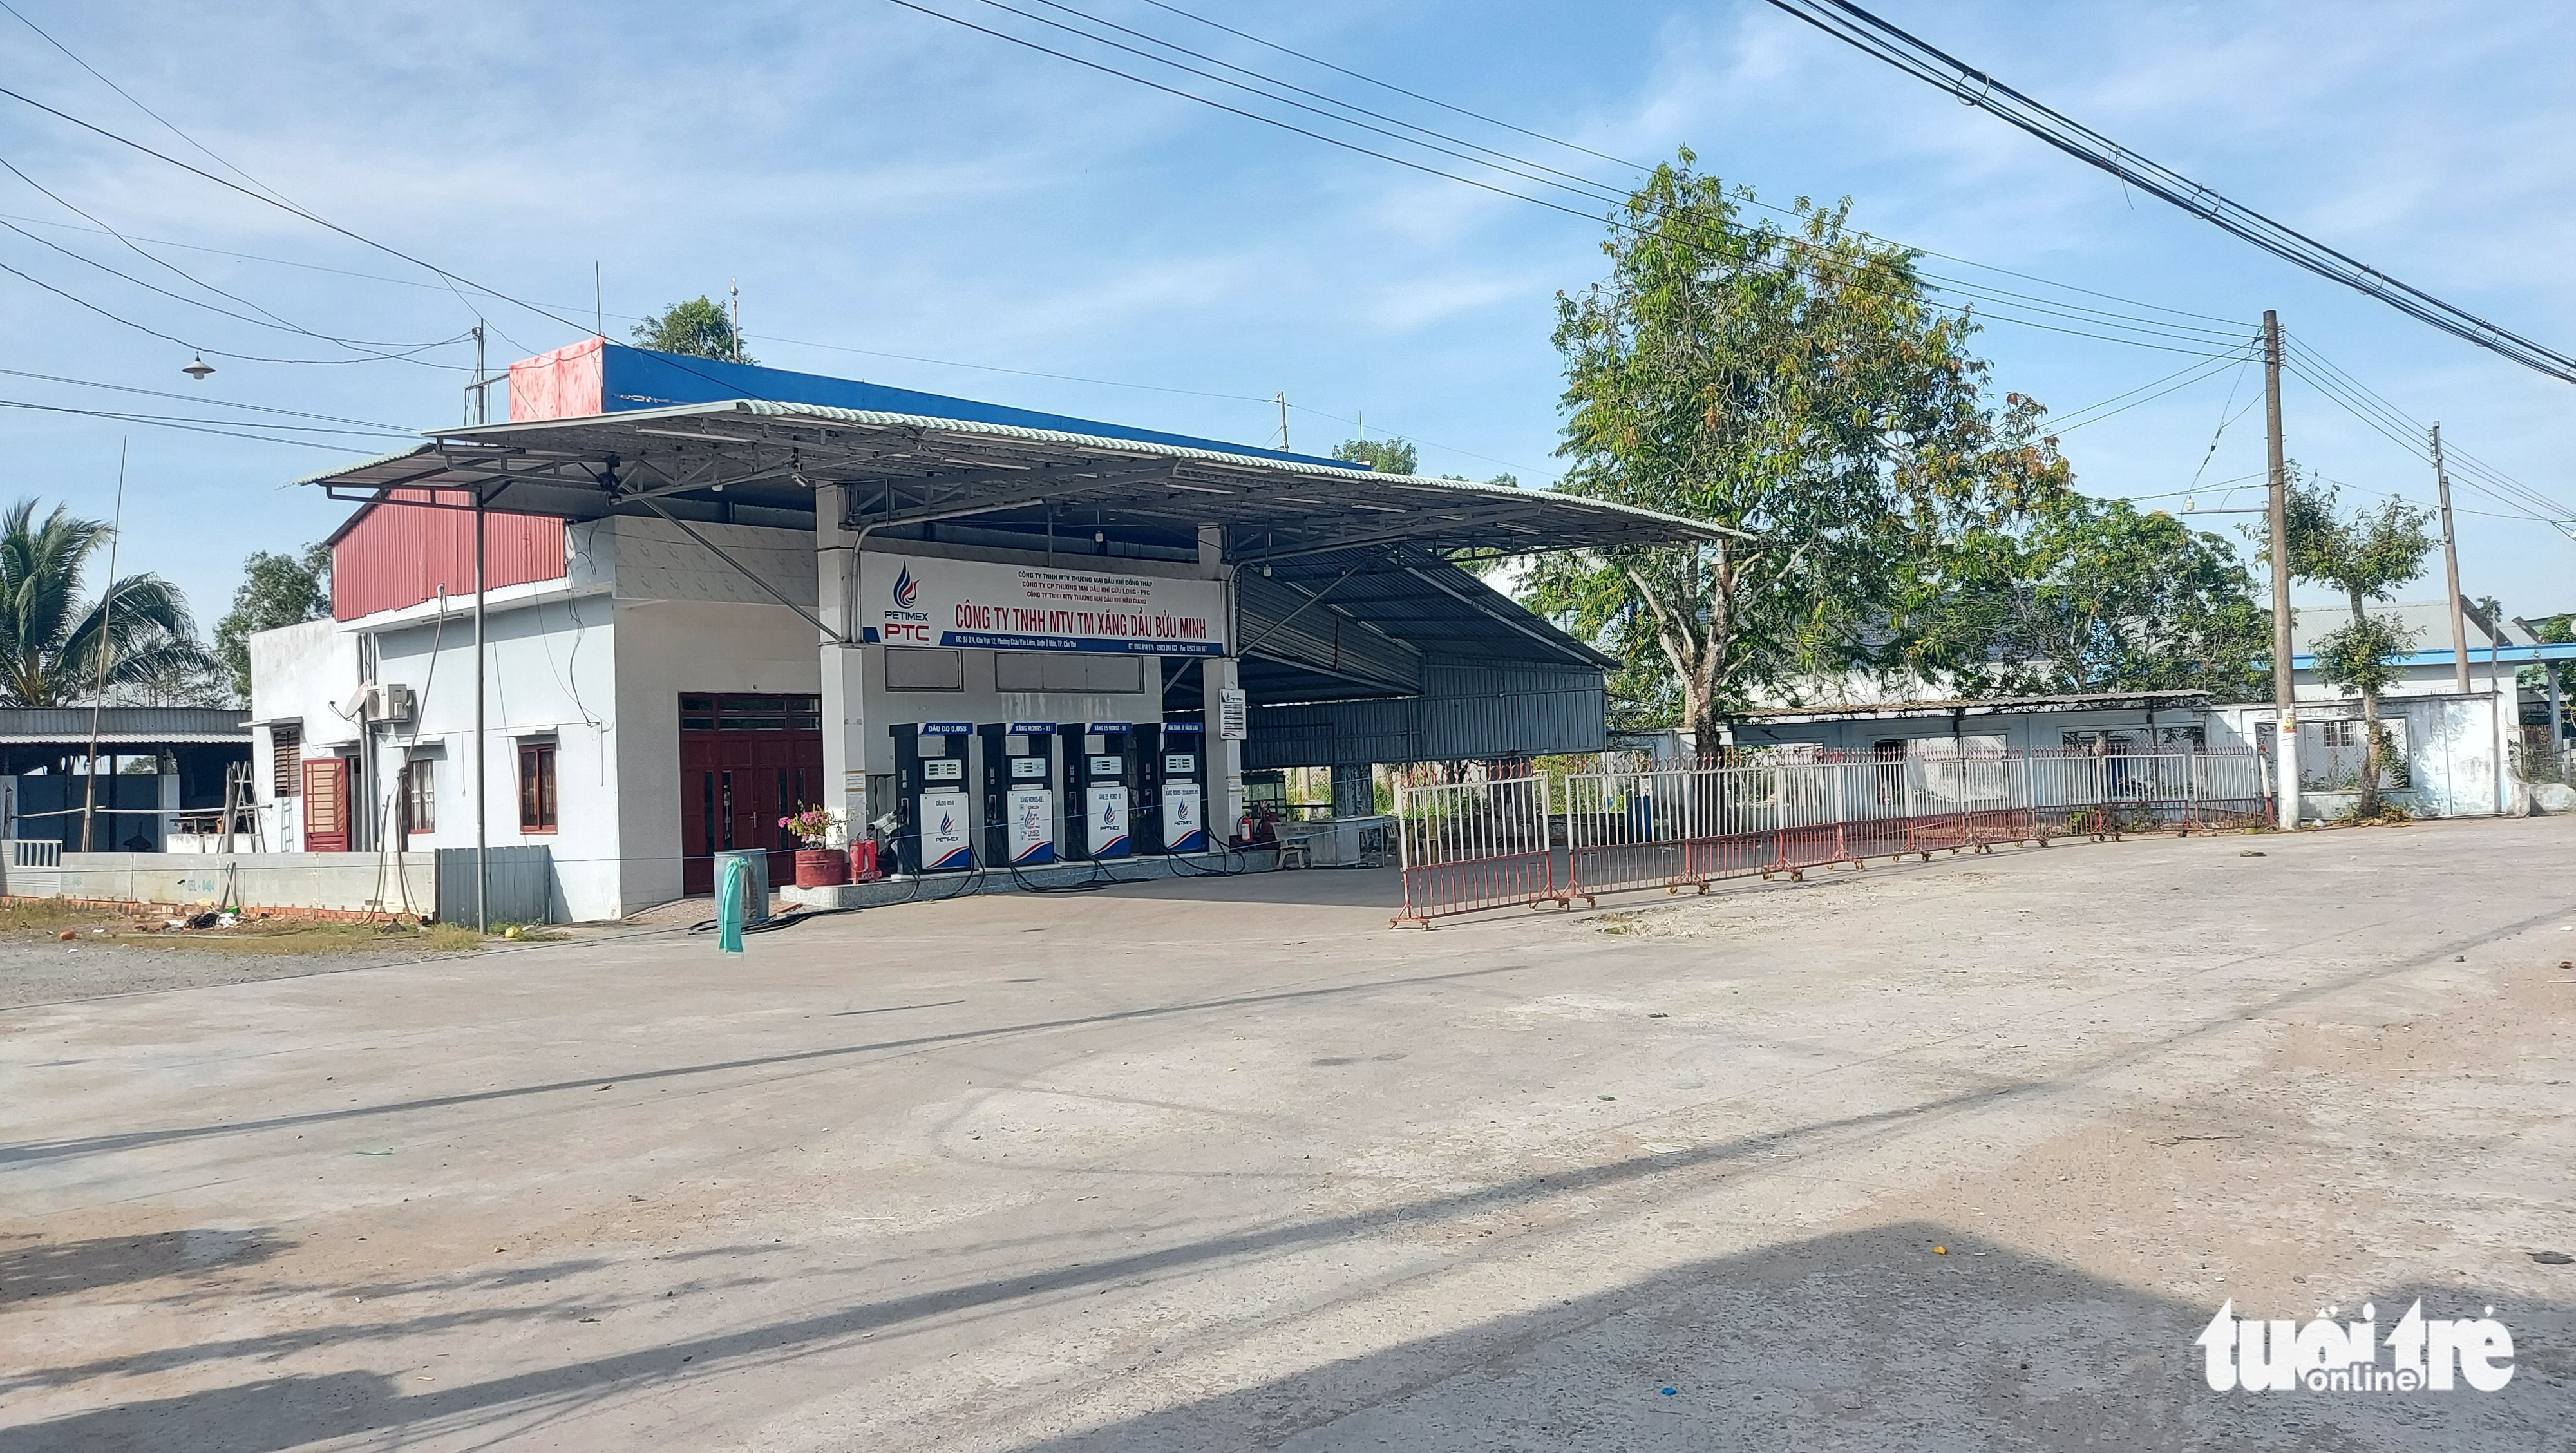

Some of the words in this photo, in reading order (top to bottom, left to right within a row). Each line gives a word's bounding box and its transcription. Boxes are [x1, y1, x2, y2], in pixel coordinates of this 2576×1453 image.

[885, 611, 929, 621] PETIMEX
[955, 599, 990, 630] CÔNG
[994, 607, 1009, 631] TY
[1013, 607, 1045, 632] TNHH
[1049, 610, 1074, 634] MTV
[1077, 611, 1094, 635] TM
[1097, 608, 1127, 636] XĂNG
[1130, 607, 1152, 638] DẦU
[1155, 609, 1177, 638] BỬU
[1179, 617, 1206, 639] MINH
[885, 623, 929, 641] PTC
